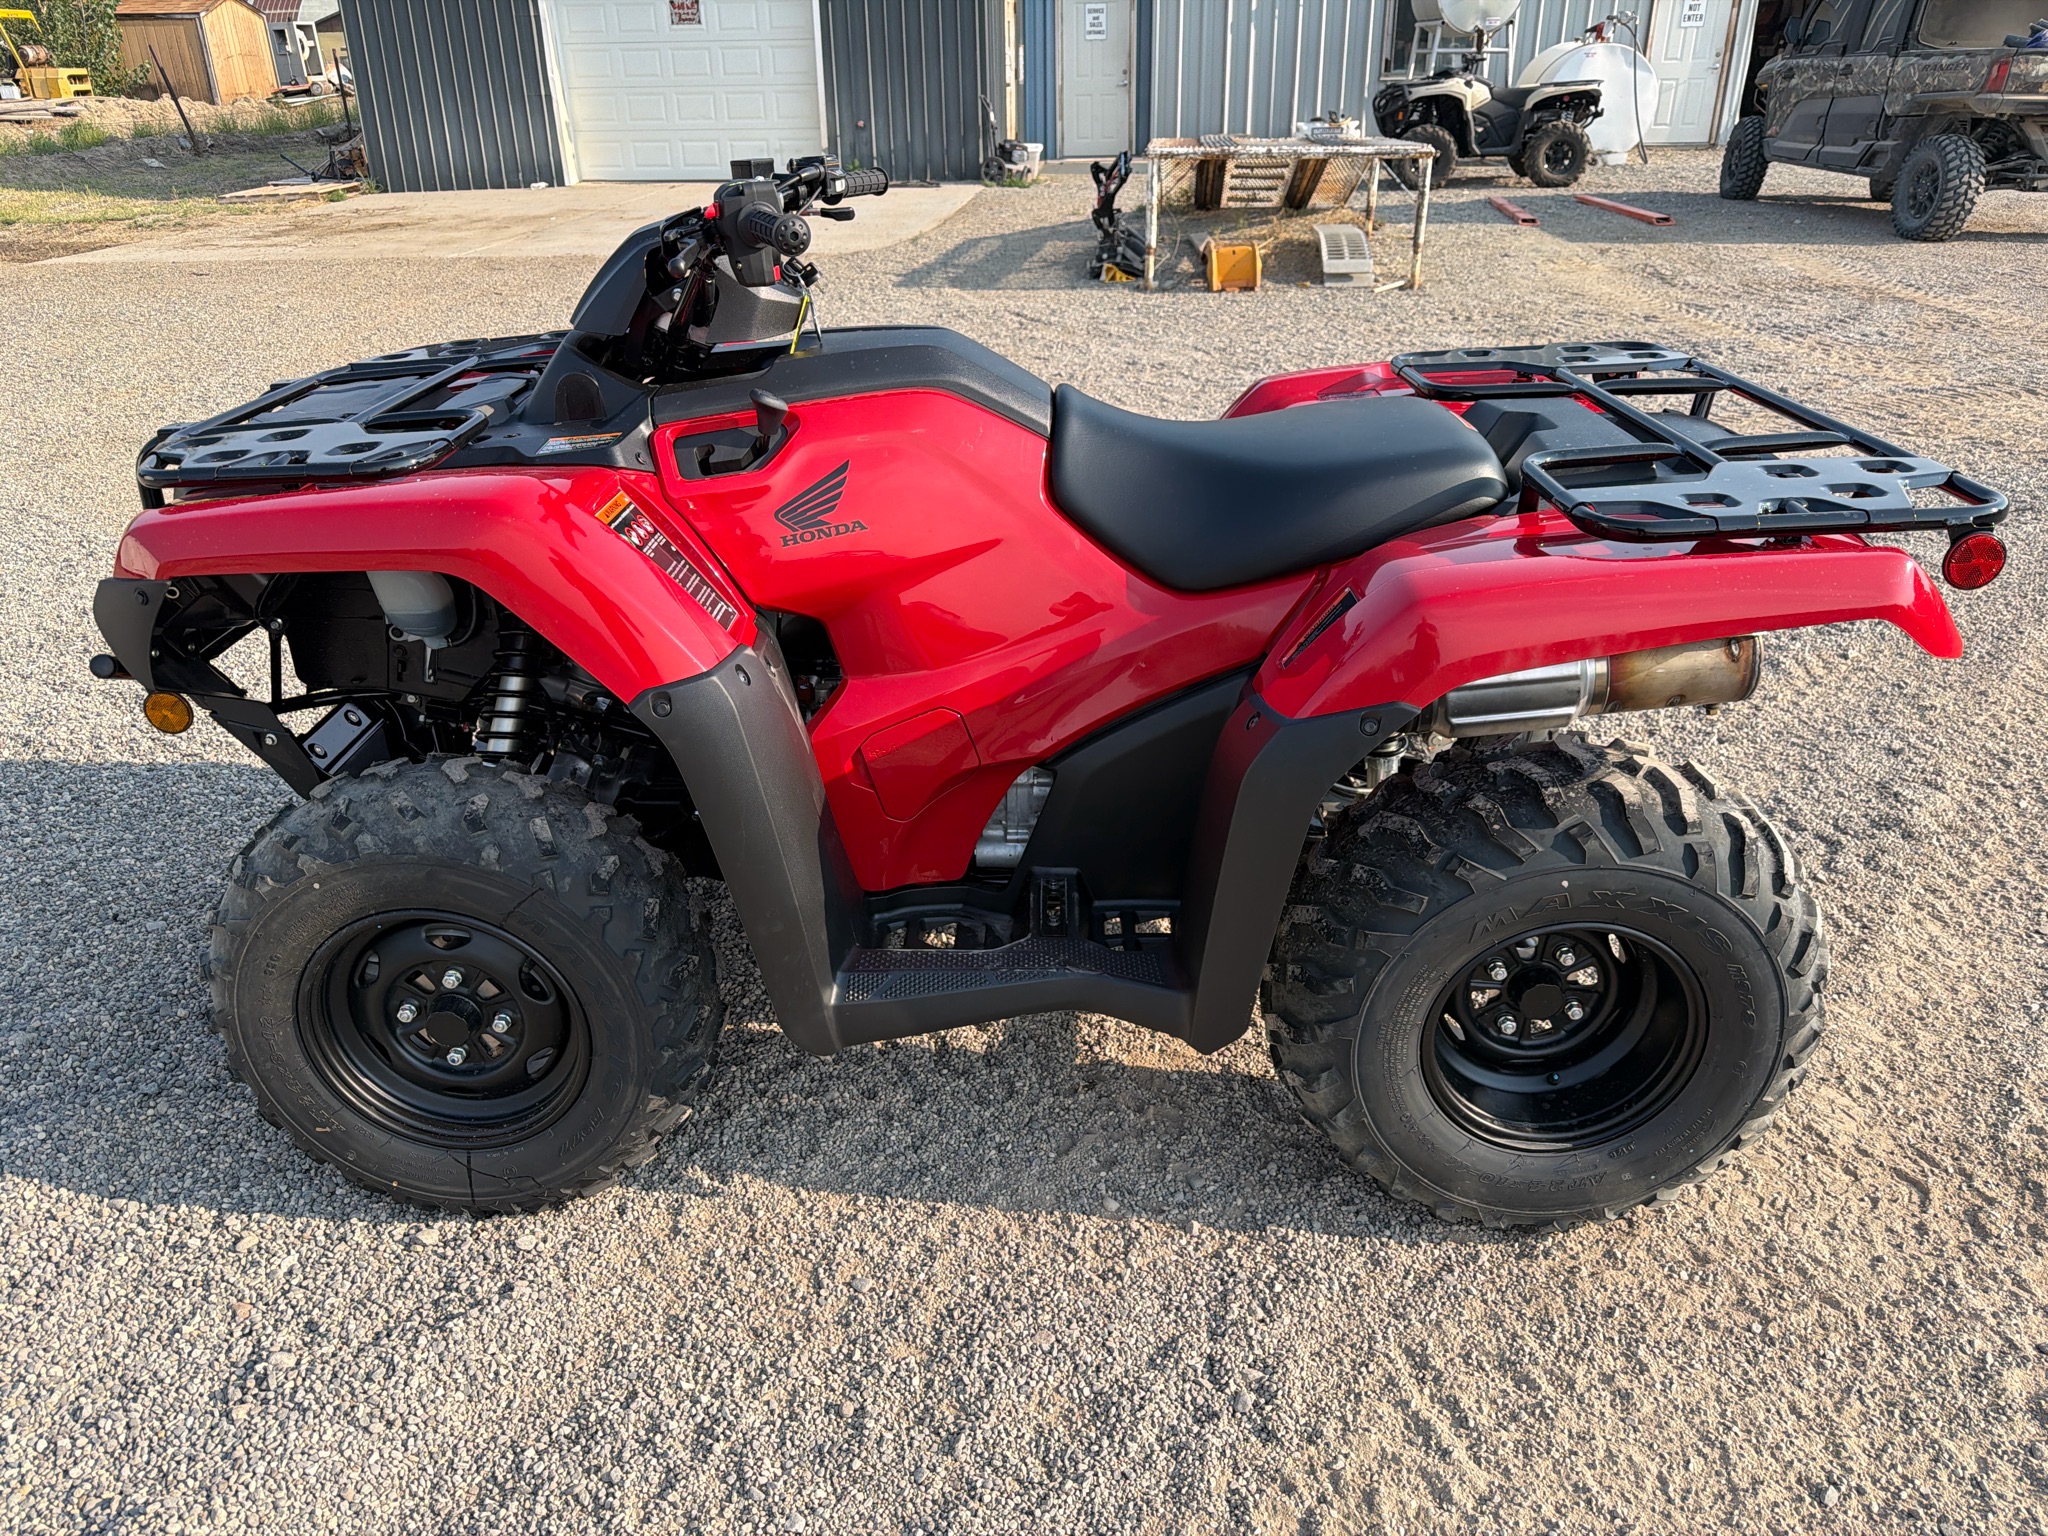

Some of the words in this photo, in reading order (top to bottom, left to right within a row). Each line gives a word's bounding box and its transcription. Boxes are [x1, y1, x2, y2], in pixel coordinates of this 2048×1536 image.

[1688, 3, 1701, 12] NOT
[1683, 14, 1703, 22] ENTER
[1921, 63, 1972, 72] RANGER
[780, 520, 868, 547] HONDA
[1468, 887, 1734, 956] MAXXIS
